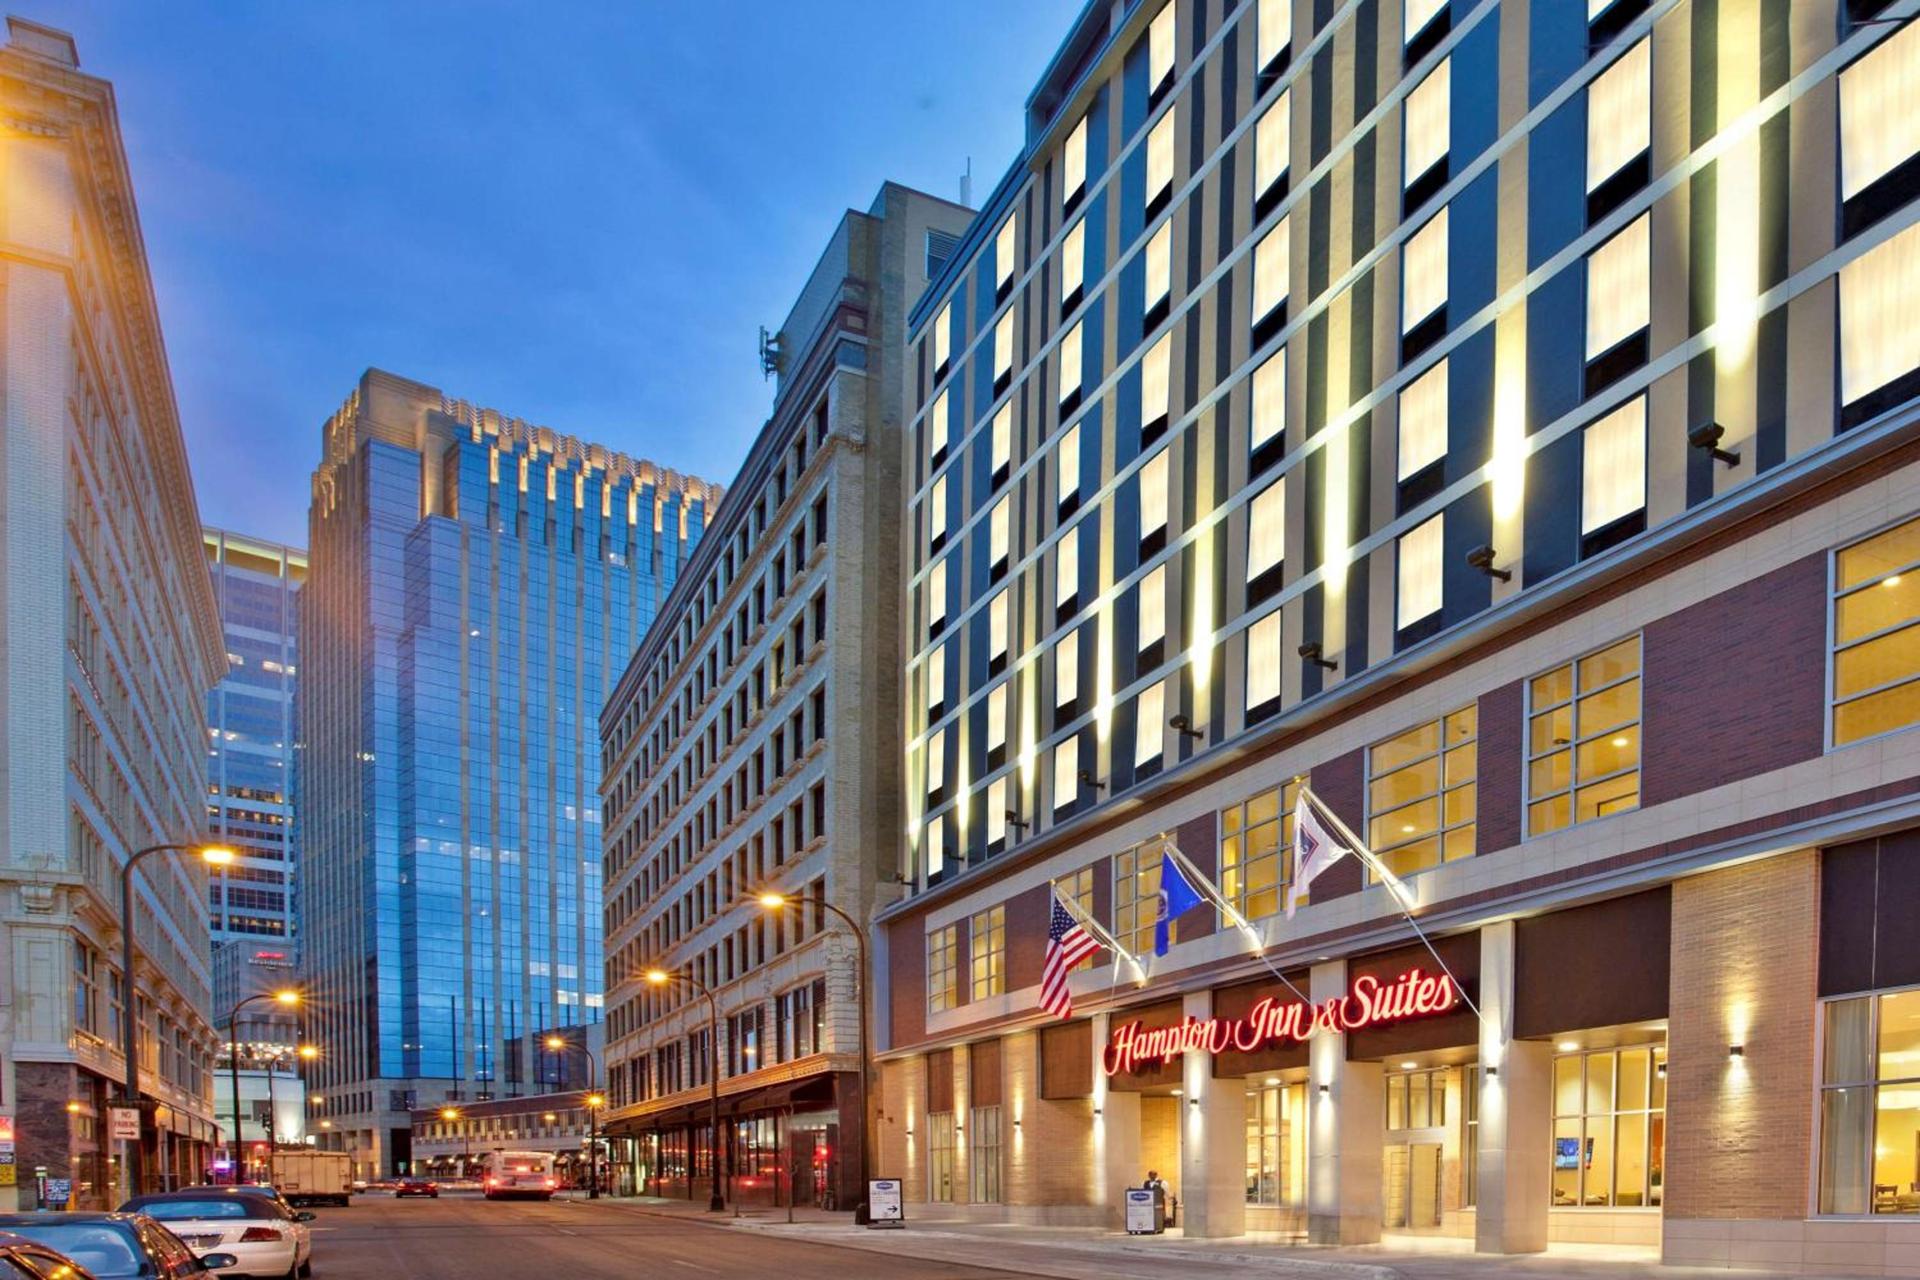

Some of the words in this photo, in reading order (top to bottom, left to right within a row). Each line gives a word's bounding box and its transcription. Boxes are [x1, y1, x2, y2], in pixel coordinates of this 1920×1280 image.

[1101, 1015, 1230, 1076] Hampton
[1234, 997, 1317, 1050] Inn
[1318, 998, 1343, 1034] &
[1339, 968, 1453, 1029] Suites
[121, 1111, 132, 1119] NO
